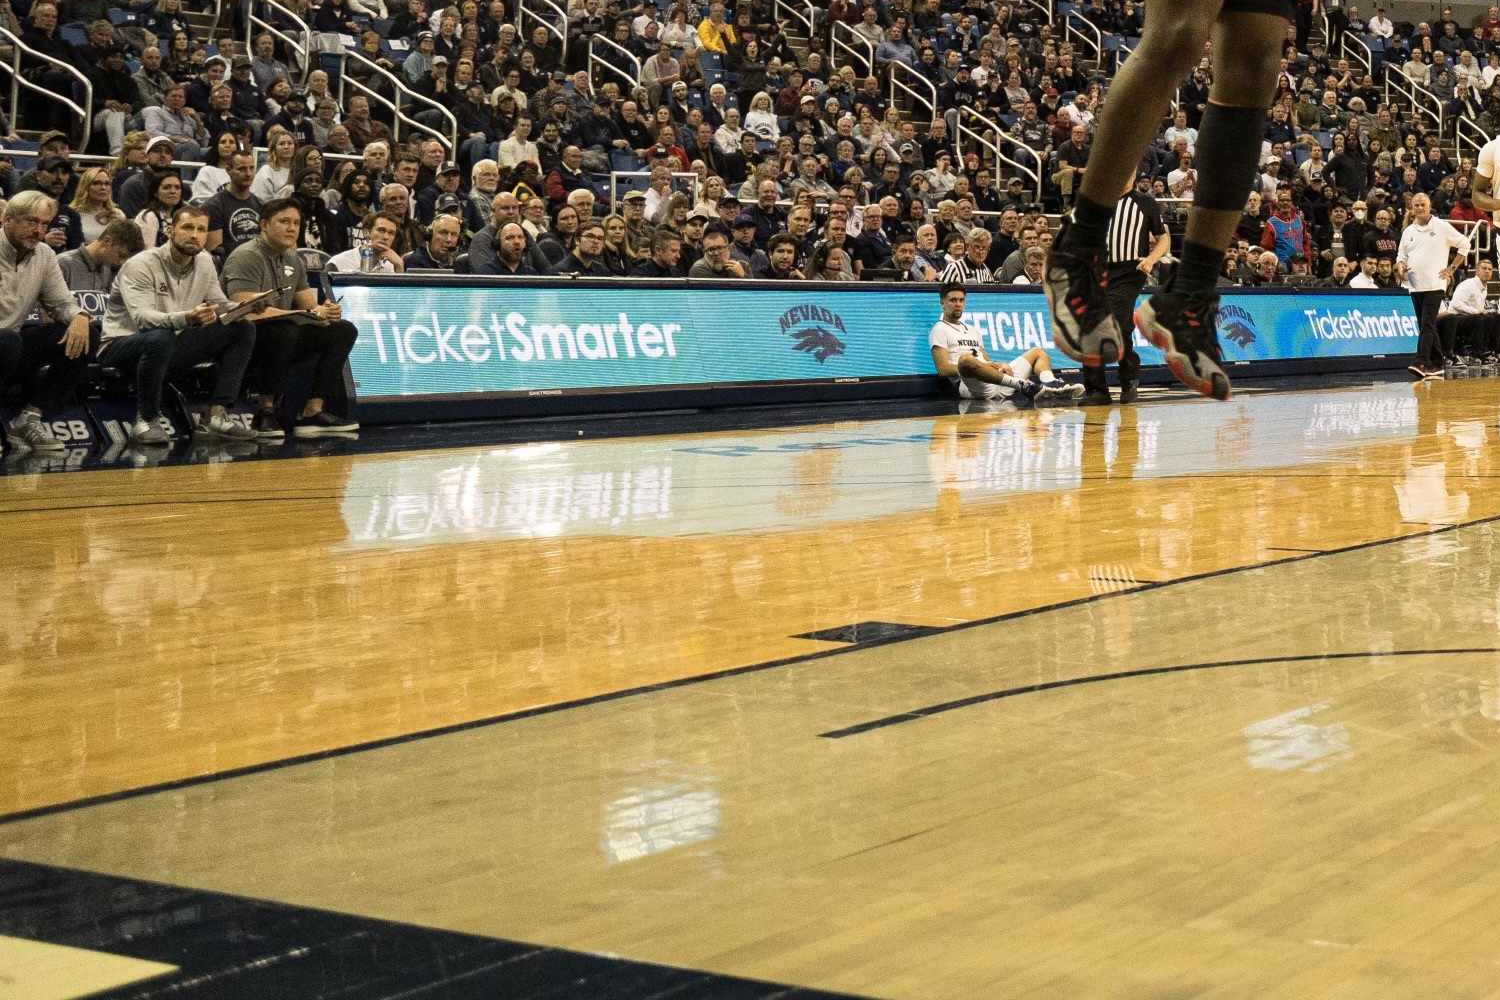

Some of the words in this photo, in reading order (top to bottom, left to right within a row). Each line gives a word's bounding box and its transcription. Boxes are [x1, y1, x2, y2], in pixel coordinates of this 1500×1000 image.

[779, 304, 846, 334] NEVADA
[962, 311, 1055, 351] FICIAL
[1304, 310, 1419, 340] TicketSmarter
[363, 312, 678, 364] TicketSmarter
